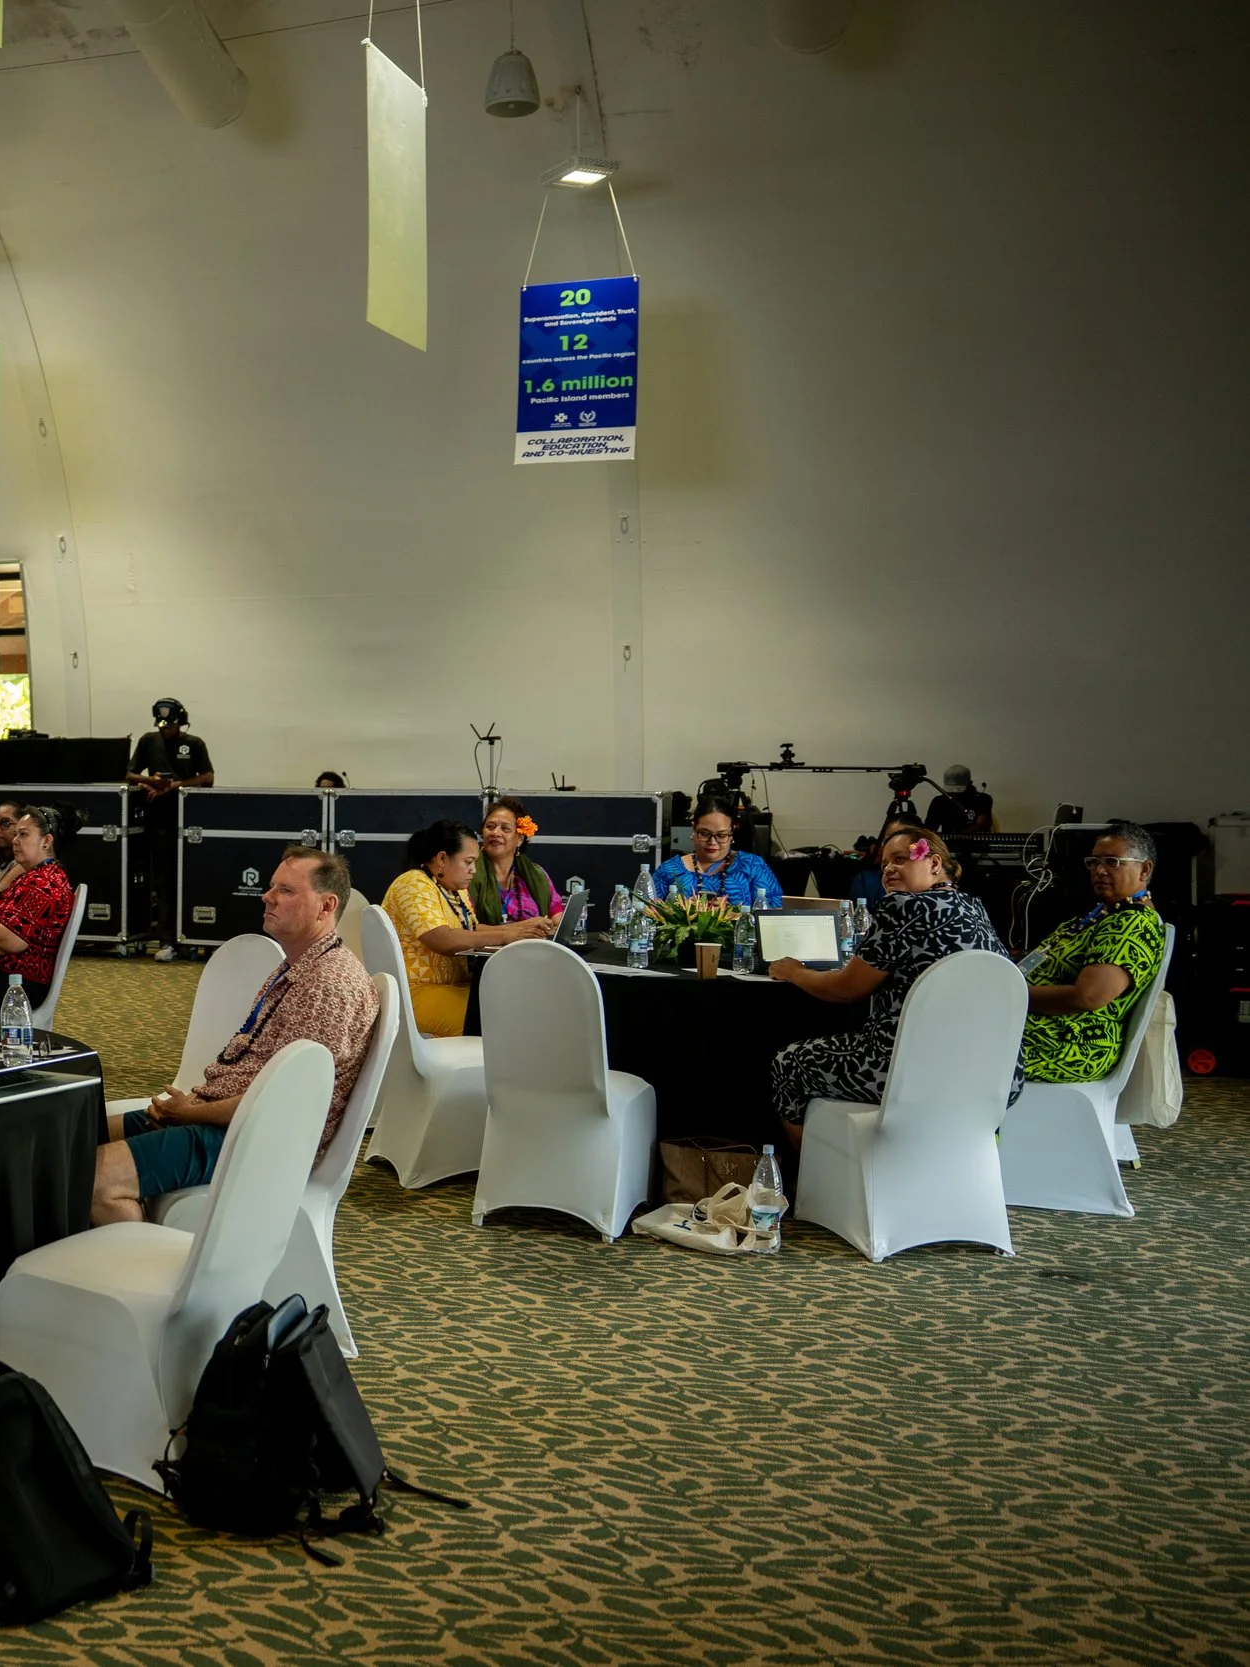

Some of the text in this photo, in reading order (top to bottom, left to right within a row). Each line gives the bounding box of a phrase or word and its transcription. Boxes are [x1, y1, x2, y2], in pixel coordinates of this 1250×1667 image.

[560, 289, 591, 307] 20
[524, 313, 580, 323] Superannuation,
[582, 309, 617, 318] Provident,
[560, 318, 594, 326] Sovereign
[559, 334, 589, 351] 12
[524, 375, 634, 393] 1.6 million
[530, 392, 630, 404] Pacific Island members
[528, 435, 624, 446] COLLABORATION,
[542, 442, 608, 451] EDUCATION,
[549, 446, 630, 456] CO-INVESTING
